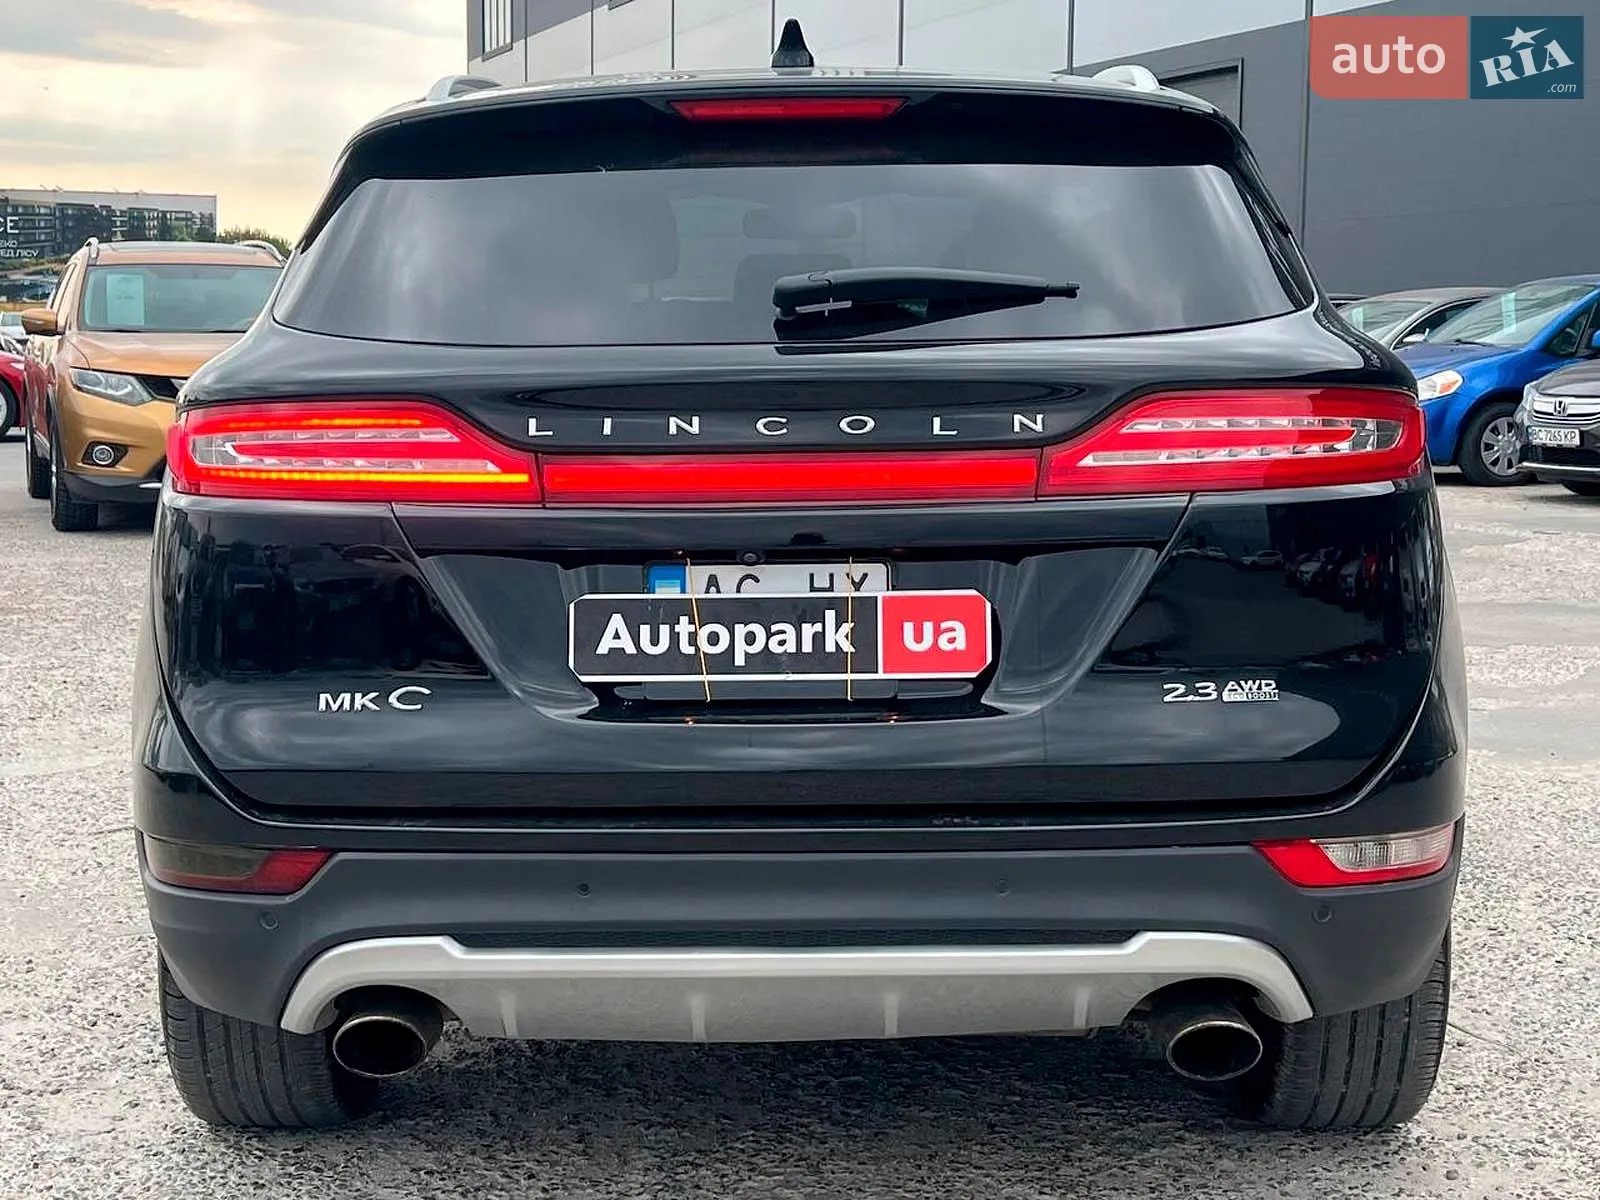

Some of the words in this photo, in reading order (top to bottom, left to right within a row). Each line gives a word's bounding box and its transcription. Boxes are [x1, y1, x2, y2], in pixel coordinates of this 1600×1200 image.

[527, 412, 1044, 437] LINCOLN
[595, 609, 856, 667] Autopark
[902, 618, 968, 652] ua
[1162, 681, 1218, 702] 2.3
[1223, 679, 1277, 692] AWD
